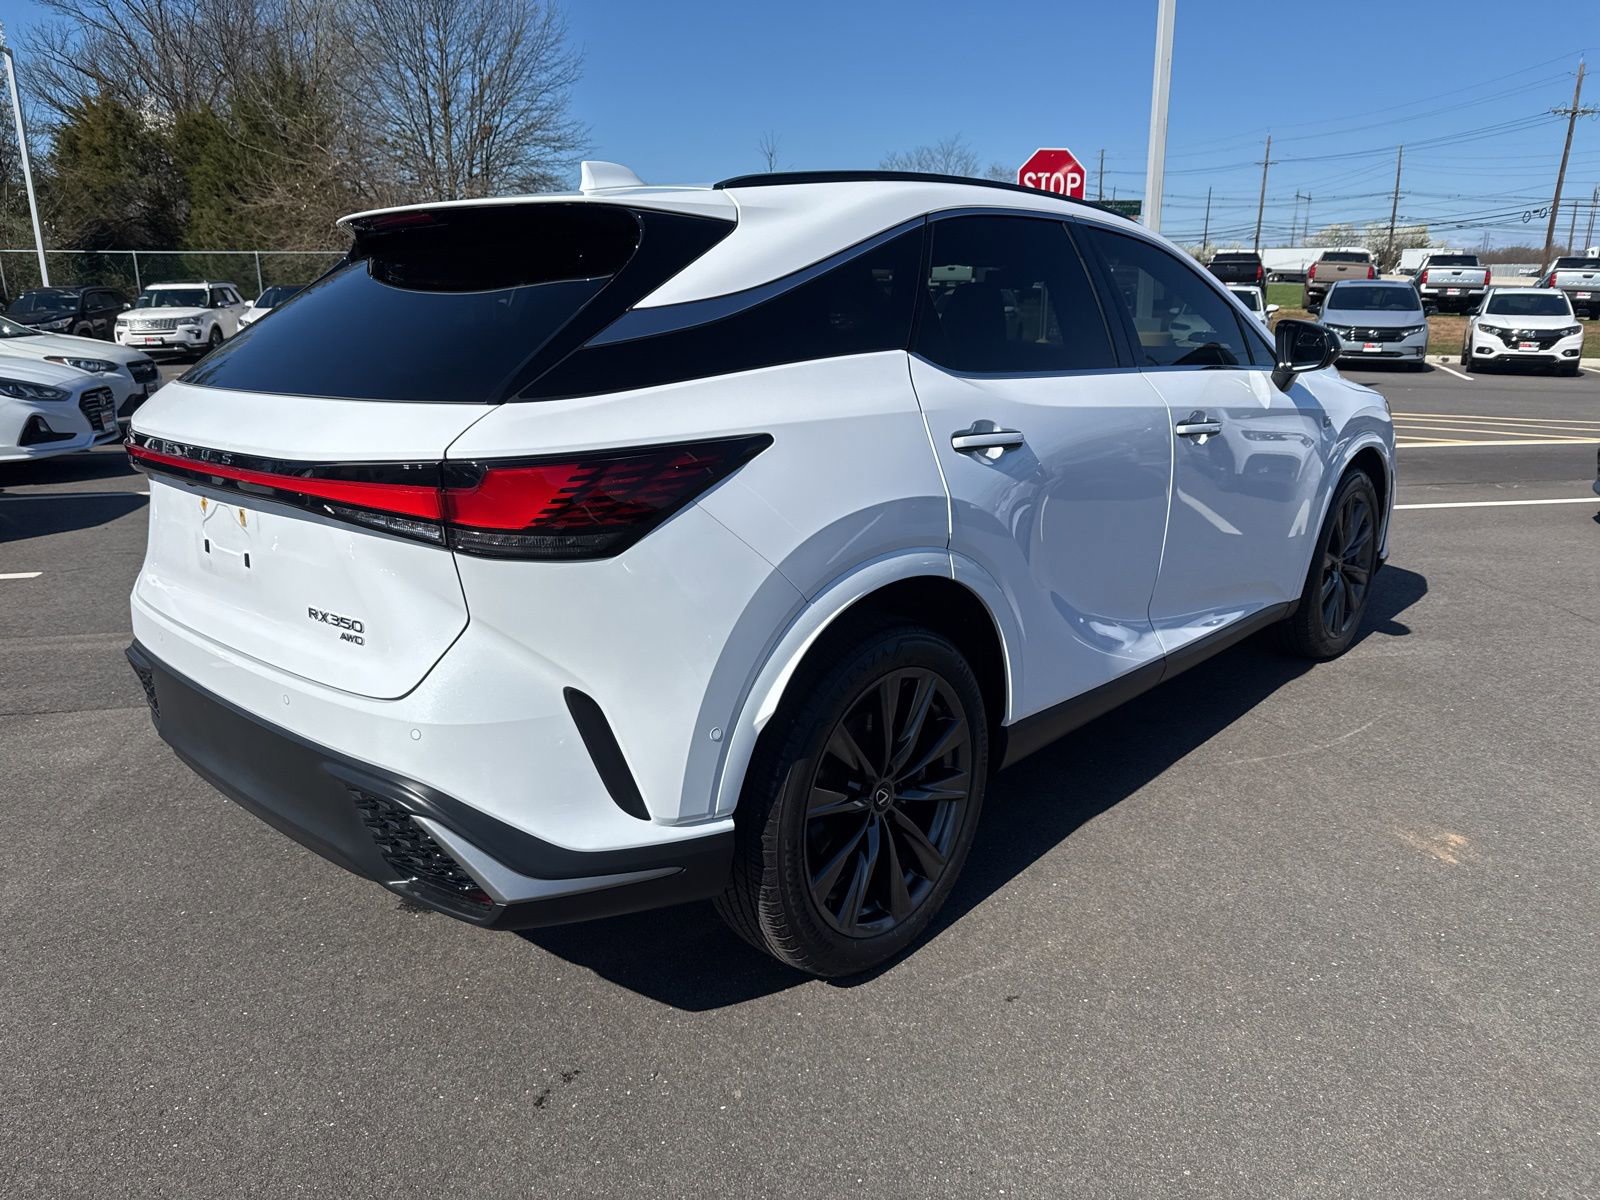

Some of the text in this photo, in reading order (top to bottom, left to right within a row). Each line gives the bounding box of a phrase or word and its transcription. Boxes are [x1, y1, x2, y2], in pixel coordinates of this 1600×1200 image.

[1023, 171, 1081, 196] STOP
[308, 607, 364, 633] RX350
[340, 632, 365, 646] AWD
